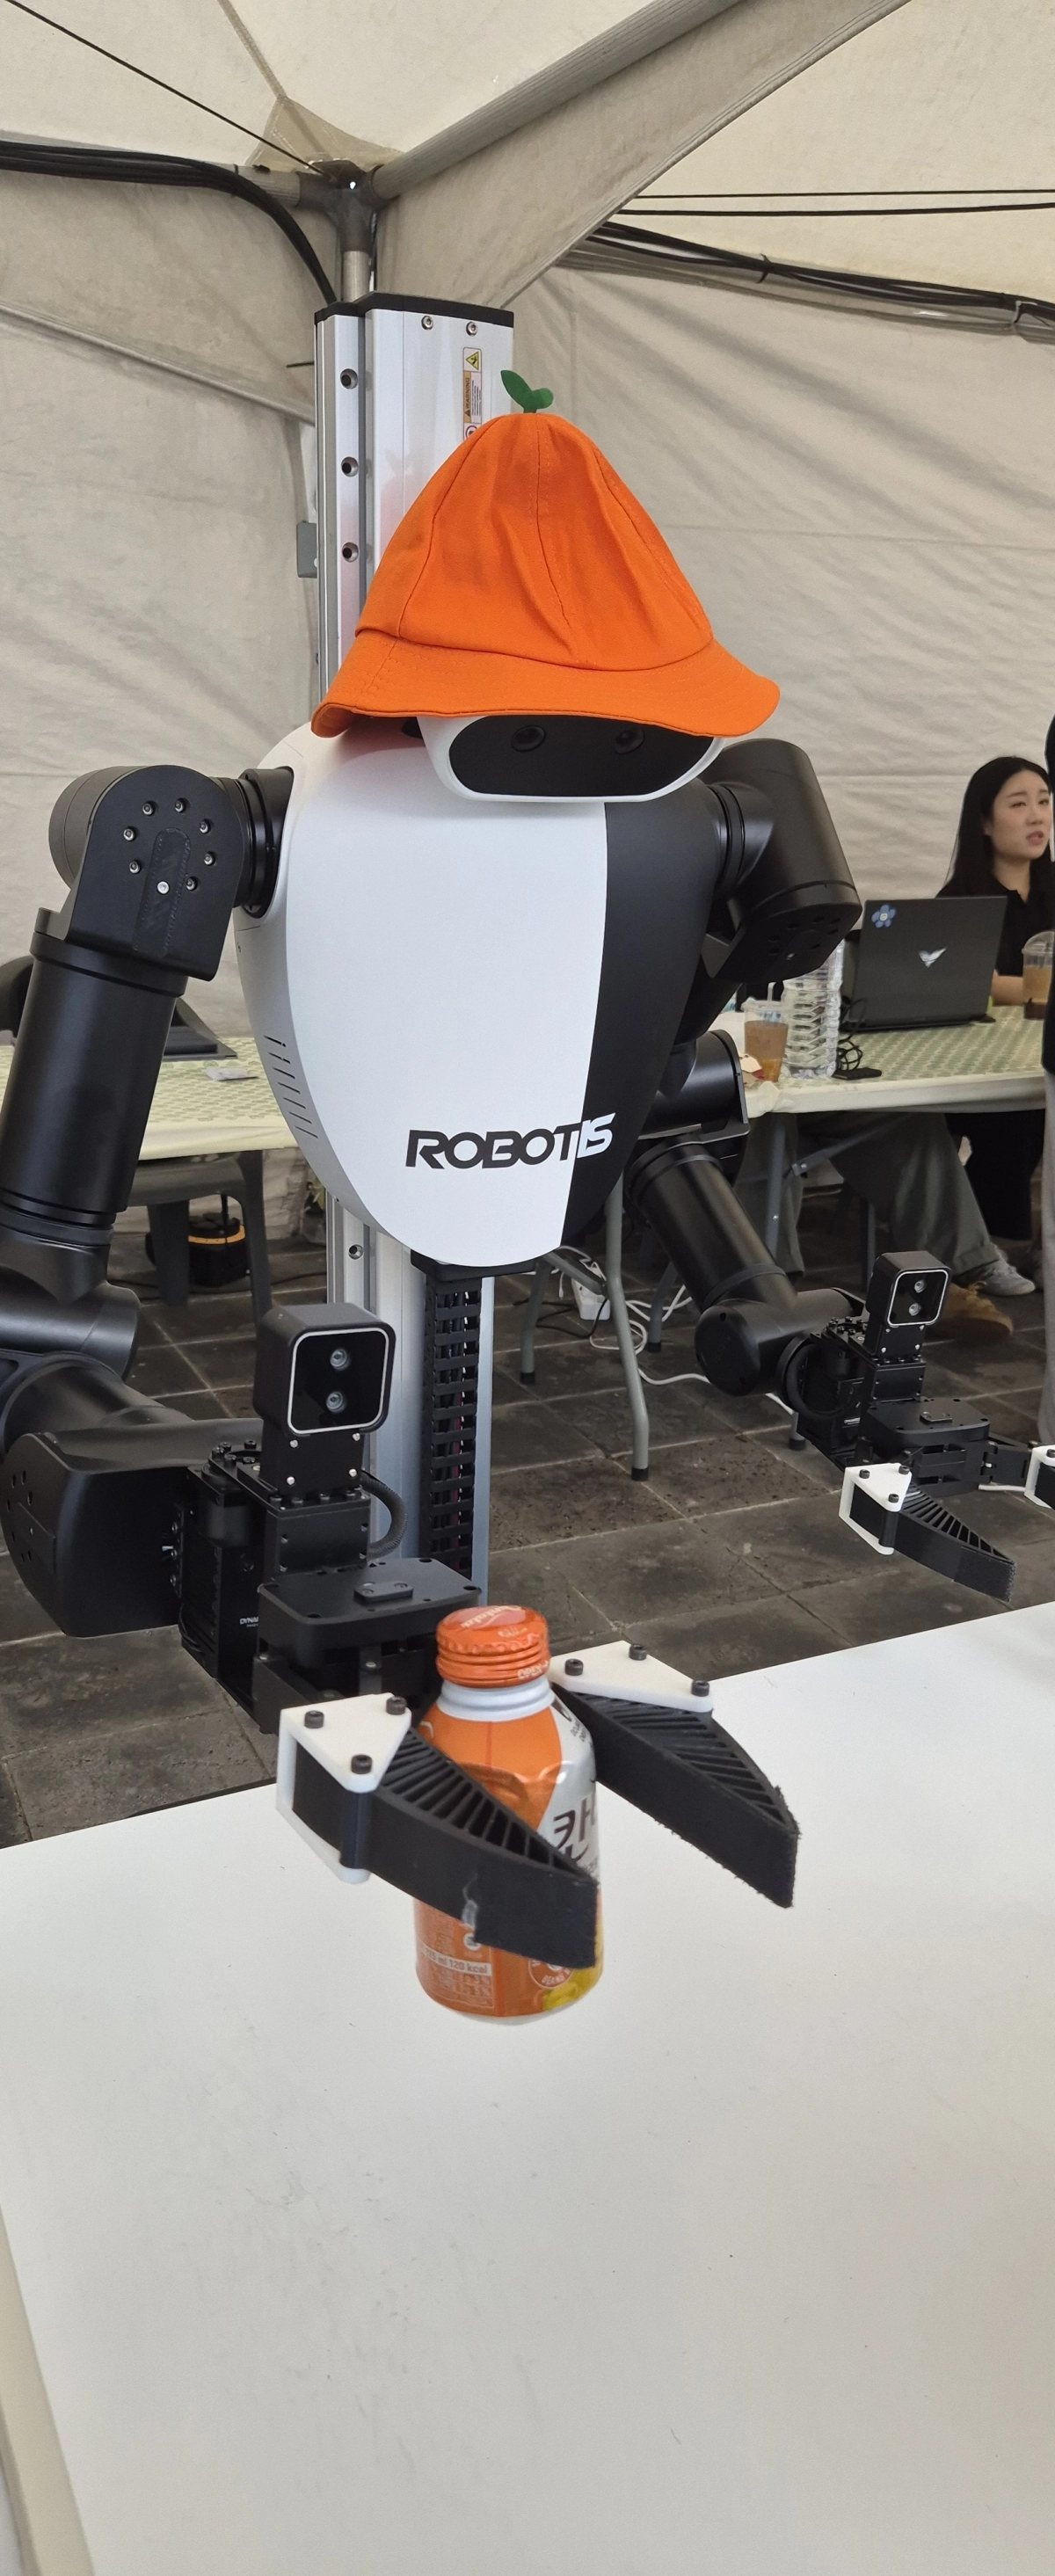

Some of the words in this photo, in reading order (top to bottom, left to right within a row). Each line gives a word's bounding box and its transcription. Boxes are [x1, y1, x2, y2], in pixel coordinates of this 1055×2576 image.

[405, 1112, 616, 1169] ROBOTIS
[449, 1960, 465, 1970] 120
[467, 1962, 488, 1974] kcal
